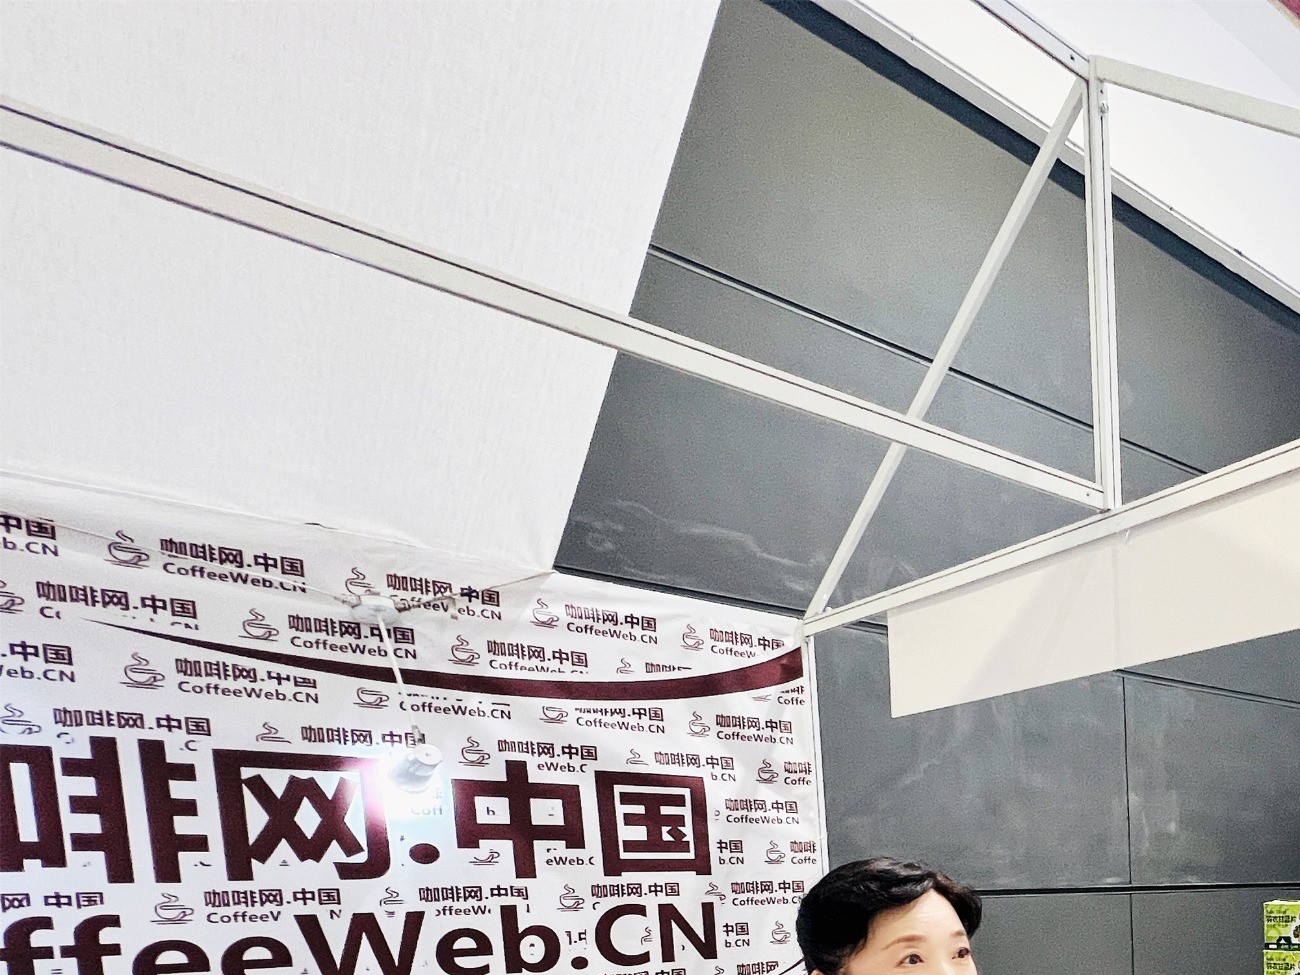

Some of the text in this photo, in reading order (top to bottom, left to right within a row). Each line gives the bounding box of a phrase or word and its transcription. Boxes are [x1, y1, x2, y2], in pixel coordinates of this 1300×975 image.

[159, 537, 306, 578] 咖啡网.中国
[386, 572, 500, 607] 咖啡网中国
[35, 581, 198, 620] 咖啡网.中国
[565, 603, 656, 632] 咖啡网.中国
[566, 622, 658, 645] CoffeeWeb.CN
[487, 639, 588, 668] 咖啡网.中国
[177, 680, 320, 704] CoffeeWeb.CN
[53, 708, 212, 737] 咖啡网.中国
[576, 715, 665, 734] CoffeeWeb.CN
[716, 714, 793, 734] 咖啡网.中国
[717, 730, 794, 745] CoffeeWeb.CN
[498, 739, 598, 761] 咖啡网.中国
[655, 752, 735, 771] 咖啡网.中国
[725, 798, 798, 814] 咖啡网.中国
[726, 813, 799, 825] CoffeeWeb.CN
[204, 888, 341, 908] 咖啡网.中国
[419, 885, 528, 903] 咖啡网.中国
[591, 882, 679, 898] 咖啡网.中国
